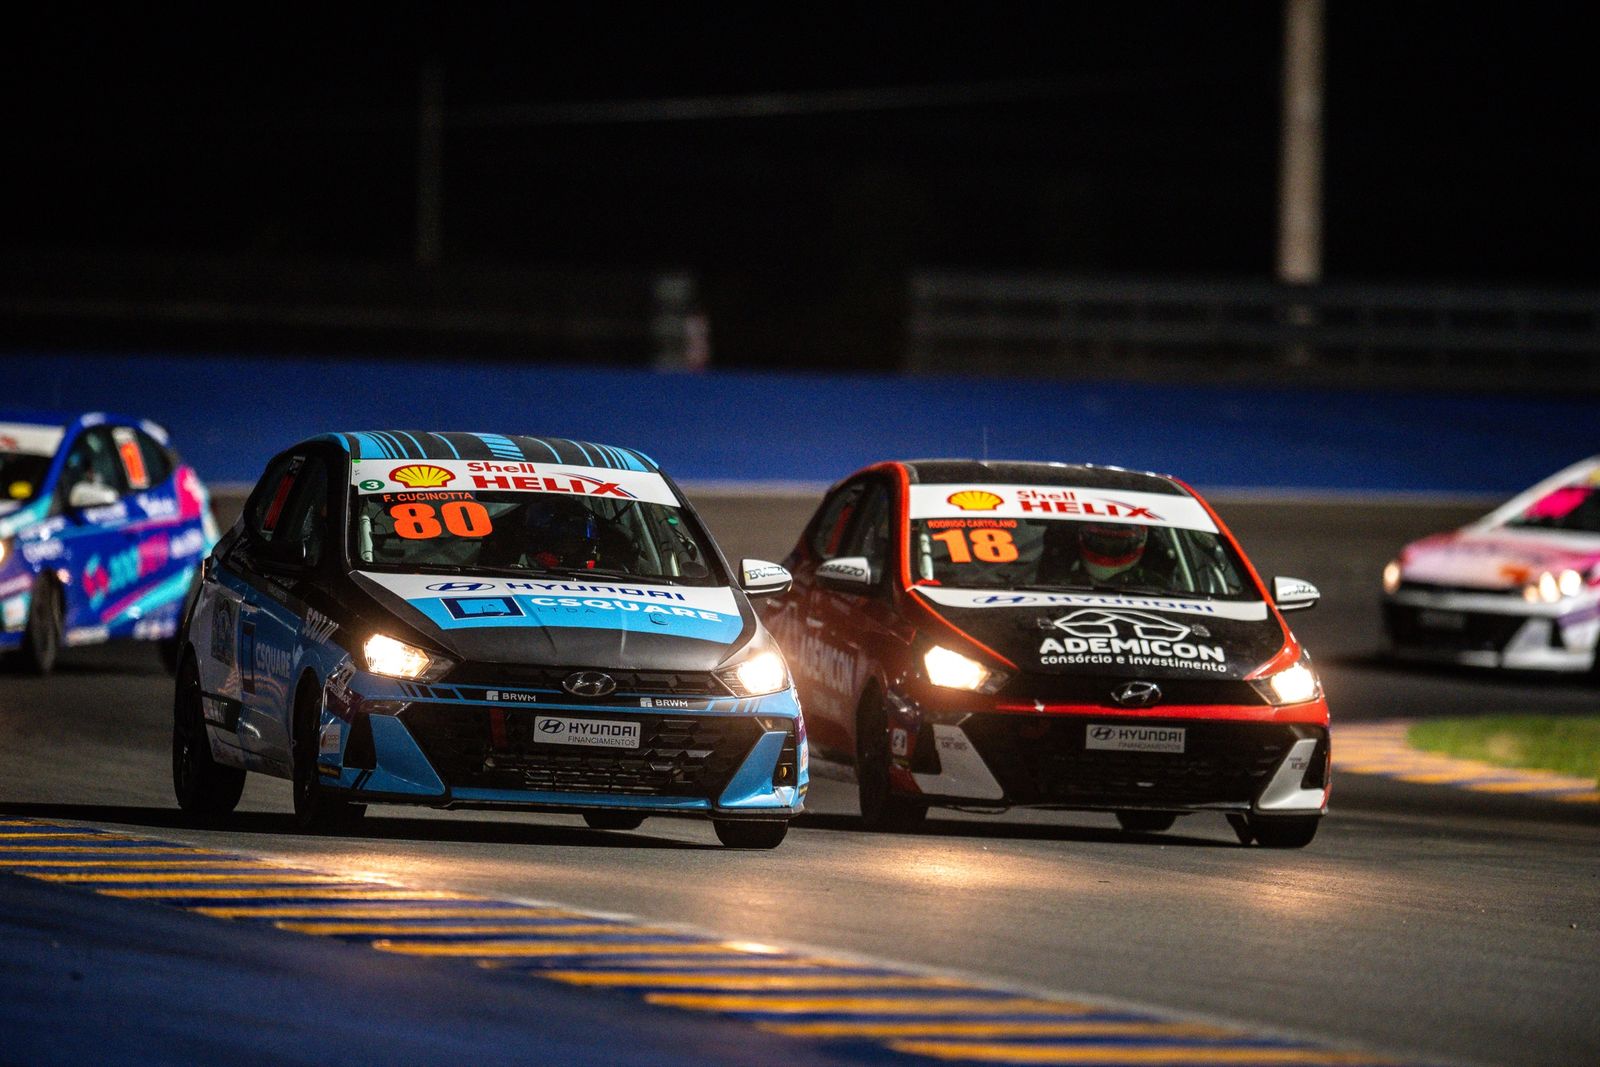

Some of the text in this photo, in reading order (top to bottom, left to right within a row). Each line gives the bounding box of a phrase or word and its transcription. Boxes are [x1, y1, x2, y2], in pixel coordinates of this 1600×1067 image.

[467, 462, 536, 474] Shell
[469, 474, 634, 498] HELIX
[383, 492, 474, 503] F. CUCINOTTA
[1016, 490, 1076, 501] Shell
[1018, 500, 1160, 521] HELIX
[390, 501, 493, 539] 80
[927, 519, 966, 529] RODRIGO
[931, 529, 1019, 563] 18
[505, 582, 686, 600] HYUNDAI
[530, 598, 723, 622] CSQUARE
[1039, 637, 1226, 662] ADEMICON
[1040, 653, 1227, 672] consórcio e investimento
[502, 692, 537, 702] BRWM
[655, 699, 689, 708] BRWM
[568, 722, 637, 737] HYUNDAI
[1119, 729, 1182, 743] HYUNDAI
[568, 736, 636, 747] FINANCIAMENTOS
